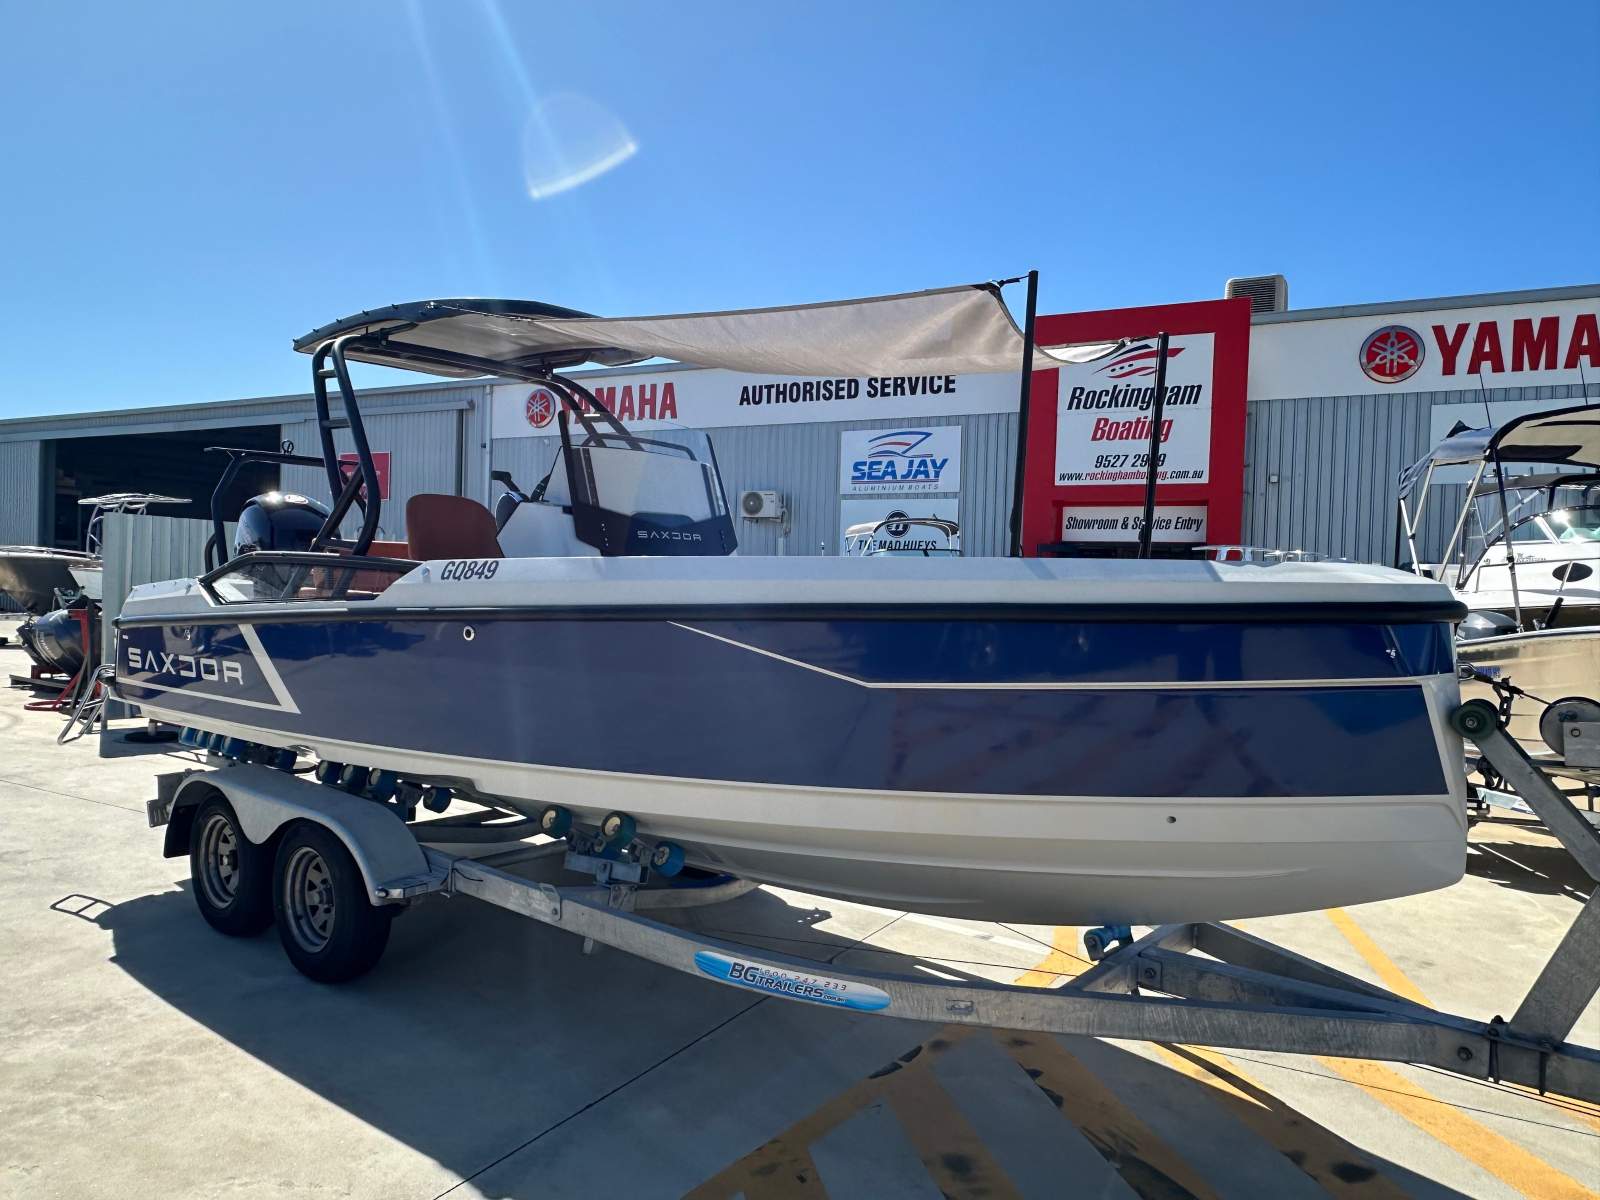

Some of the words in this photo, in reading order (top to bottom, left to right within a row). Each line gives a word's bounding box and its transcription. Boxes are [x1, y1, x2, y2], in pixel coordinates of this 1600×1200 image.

[739, 378, 859, 405] AUTHORISED
[866, 375, 956, 398] SERVICE
[1067, 384, 1202, 411] Rockingam
[851, 460, 897, 480] SEA
[901, 458, 949, 479] JAY
[1094, 454, 1128, 468] 9527
[1131, 453, 1166, 467] 299
[1059, 470, 1204, 481] www.rockinghambong.com.au
[1065, 516, 1119, 530] Showroom
[1121, 516, 1129, 529] &
[1174, 516, 1203, 532] Entry
[637, 530, 702, 541] SAXDOR
[879, 540, 900, 550] MAD
[903, 540, 936, 550] HUEYS
[440, 560, 499, 581] GQ849
[128, 648, 244, 685] SAXDOR
[729, 961, 759, 983] BG
[757, 975, 824, 998] TRAILERS
